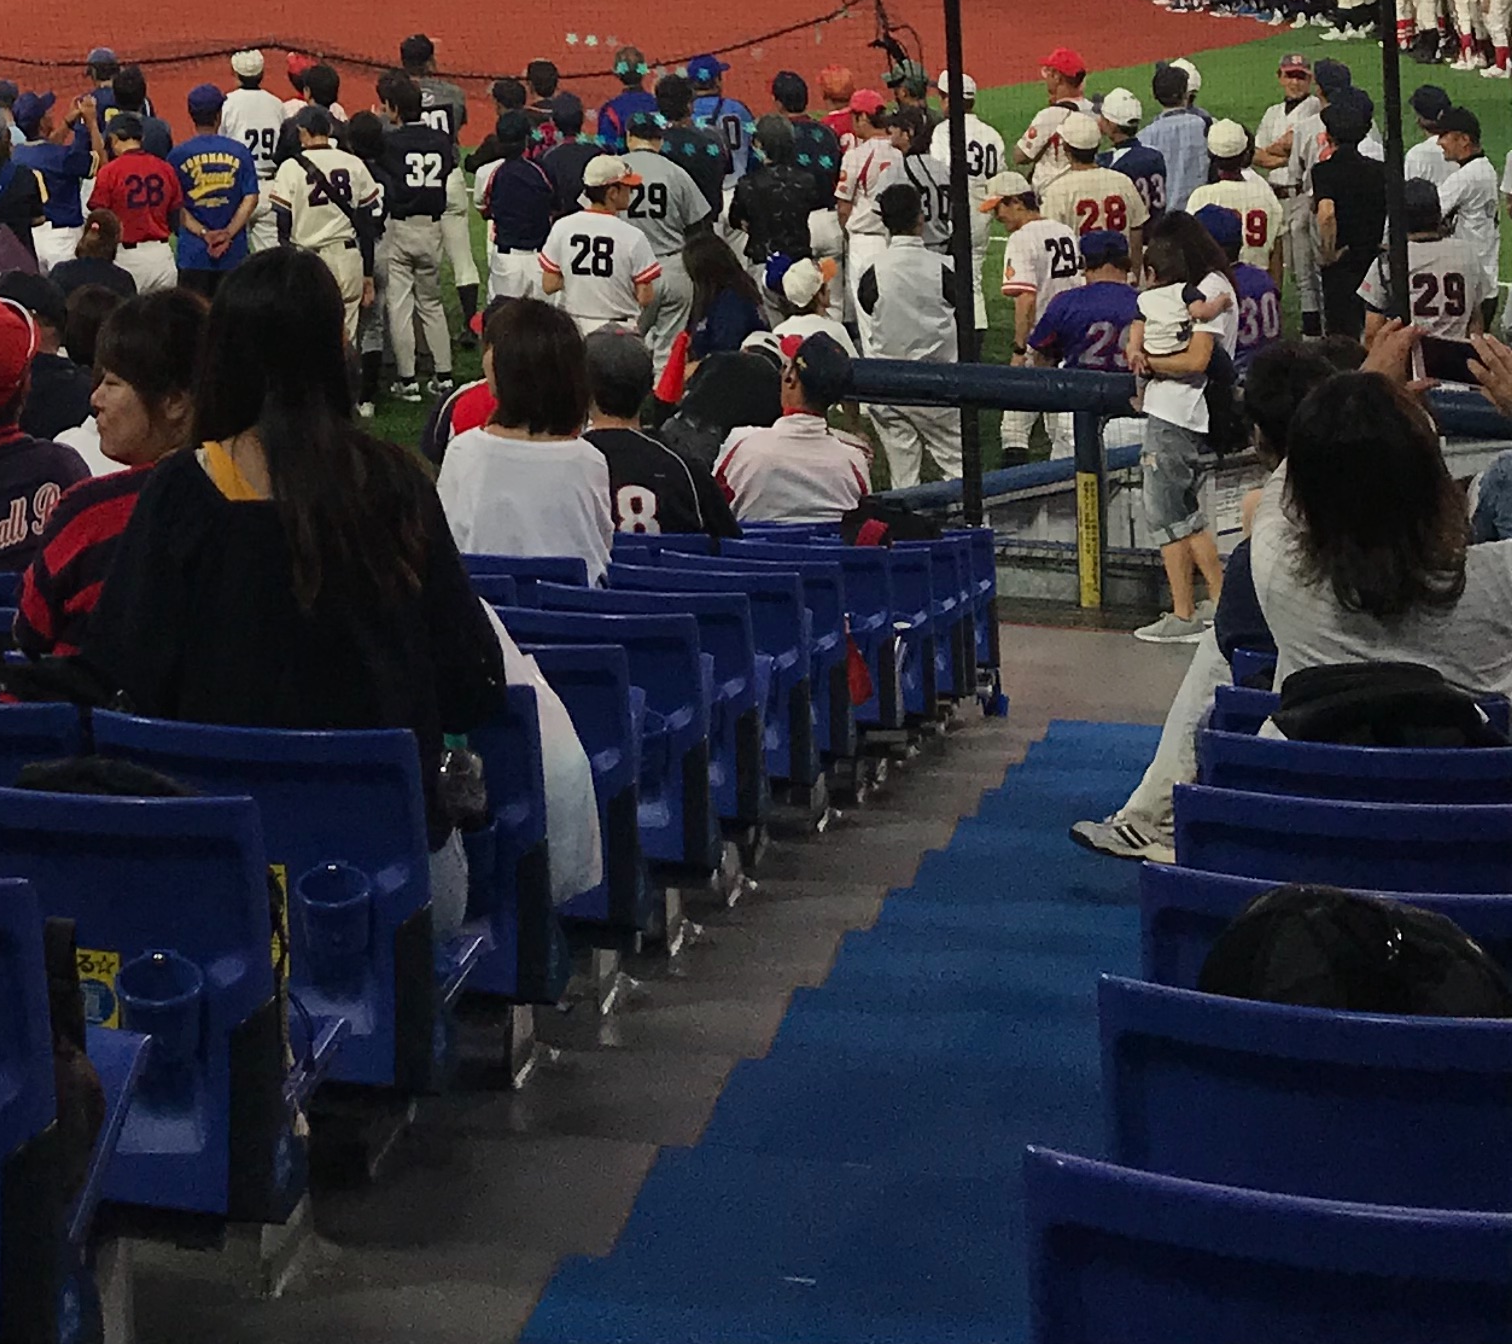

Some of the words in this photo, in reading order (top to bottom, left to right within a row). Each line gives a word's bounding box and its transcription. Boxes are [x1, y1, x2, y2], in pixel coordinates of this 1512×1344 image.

[180, 152, 240, 173] YOKOHAMA
[244, 127, 276, 162] 29
[967, 140, 998, 180] 30
[306, 168, 354, 208] 28
[404, 152, 443, 188] 32
[125, 172, 166, 209] 28
[627, 182, 668, 219] 29
[1075, 195, 1127, 236] 28
[570, 234, 615, 278] 28
[1044, 237, 1080, 280] 29
[1412, 272, 1467, 318] 29
[1238, 291, 1282, 345] 30
